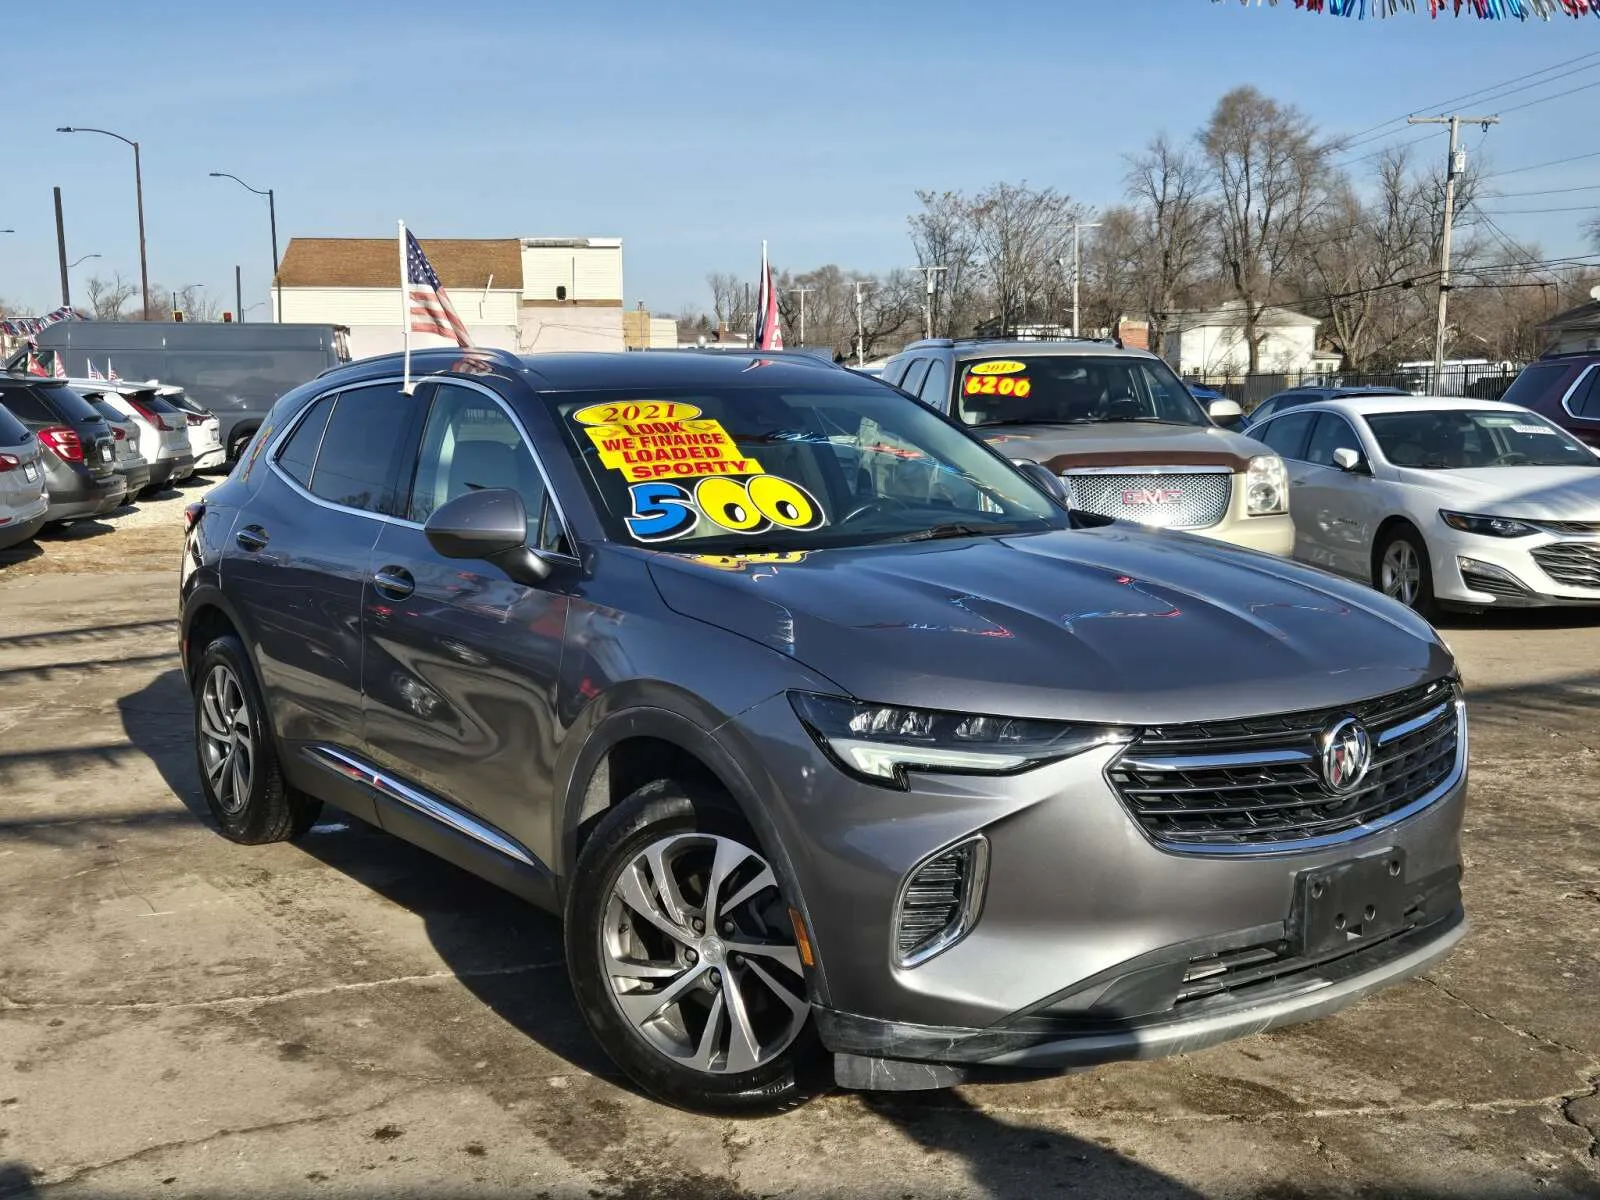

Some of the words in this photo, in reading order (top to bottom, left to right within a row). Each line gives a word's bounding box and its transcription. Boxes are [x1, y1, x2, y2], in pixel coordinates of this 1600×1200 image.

[966, 376, 1031, 396] 6200
[603, 403, 677, 422] 2021
[623, 421, 686, 436] LOOK
[601, 438, 636, 452] WE
[642, 433, 724, 447] FINANCE
[622, 446, 721, 465] LOADED
[632, 460, 748, 478] SPORTY
[1122, 489, 1184, 504] GMC
